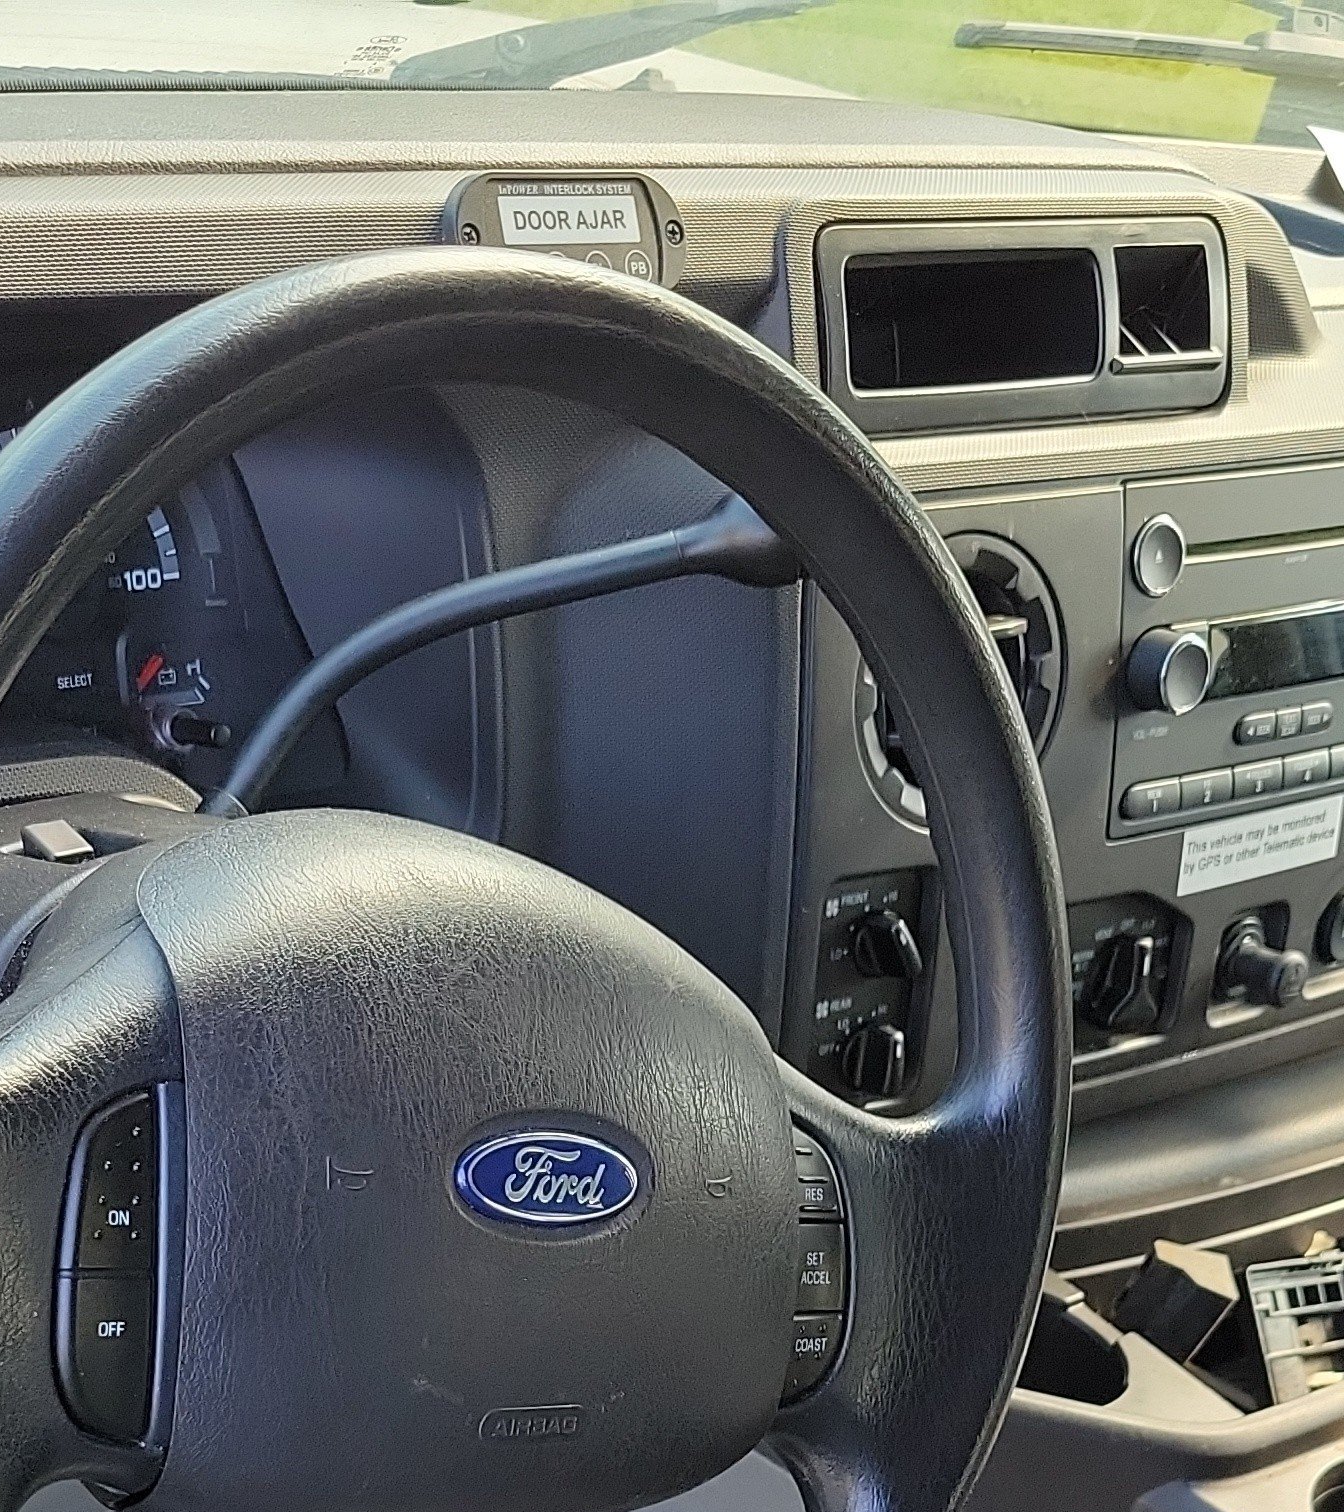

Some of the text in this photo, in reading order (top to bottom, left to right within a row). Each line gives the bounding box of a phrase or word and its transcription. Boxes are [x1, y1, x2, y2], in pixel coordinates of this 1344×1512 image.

[543, 184, 595, 195] INTERLOCK
[596, 184, 632, 194] SYSTEM
[513, 209, 627, 231] DOOR AJAR
[630, 261, 647, 275] PB
[124, 567, 162, 592] 100
[57, 672, 93, 690] SELECT
[1186, 810, 1327, 856] This vehicle may be monitored
[1197, 854, 1221, 872] GPS
[1223, 853, 1233, 866] or
[1235, 845, 1261, 863] other
[1263, 835, 1305, 855] Telematic
[1307, 827, 1336, 844] device
[504, 1145, 606, 1210] Ford
[805, 1187, 824, 1202] RES
[107, 1209, 130, 1226] ON
[806, 1251, 825, 1266] SET
[800, 1270, 832, 1285] ACCEL
[97, 1321, 126, 1338] OFF
[794, 1336, 828, 1352] COAST
[490, 1414, 579, 1438] AIRBAG
